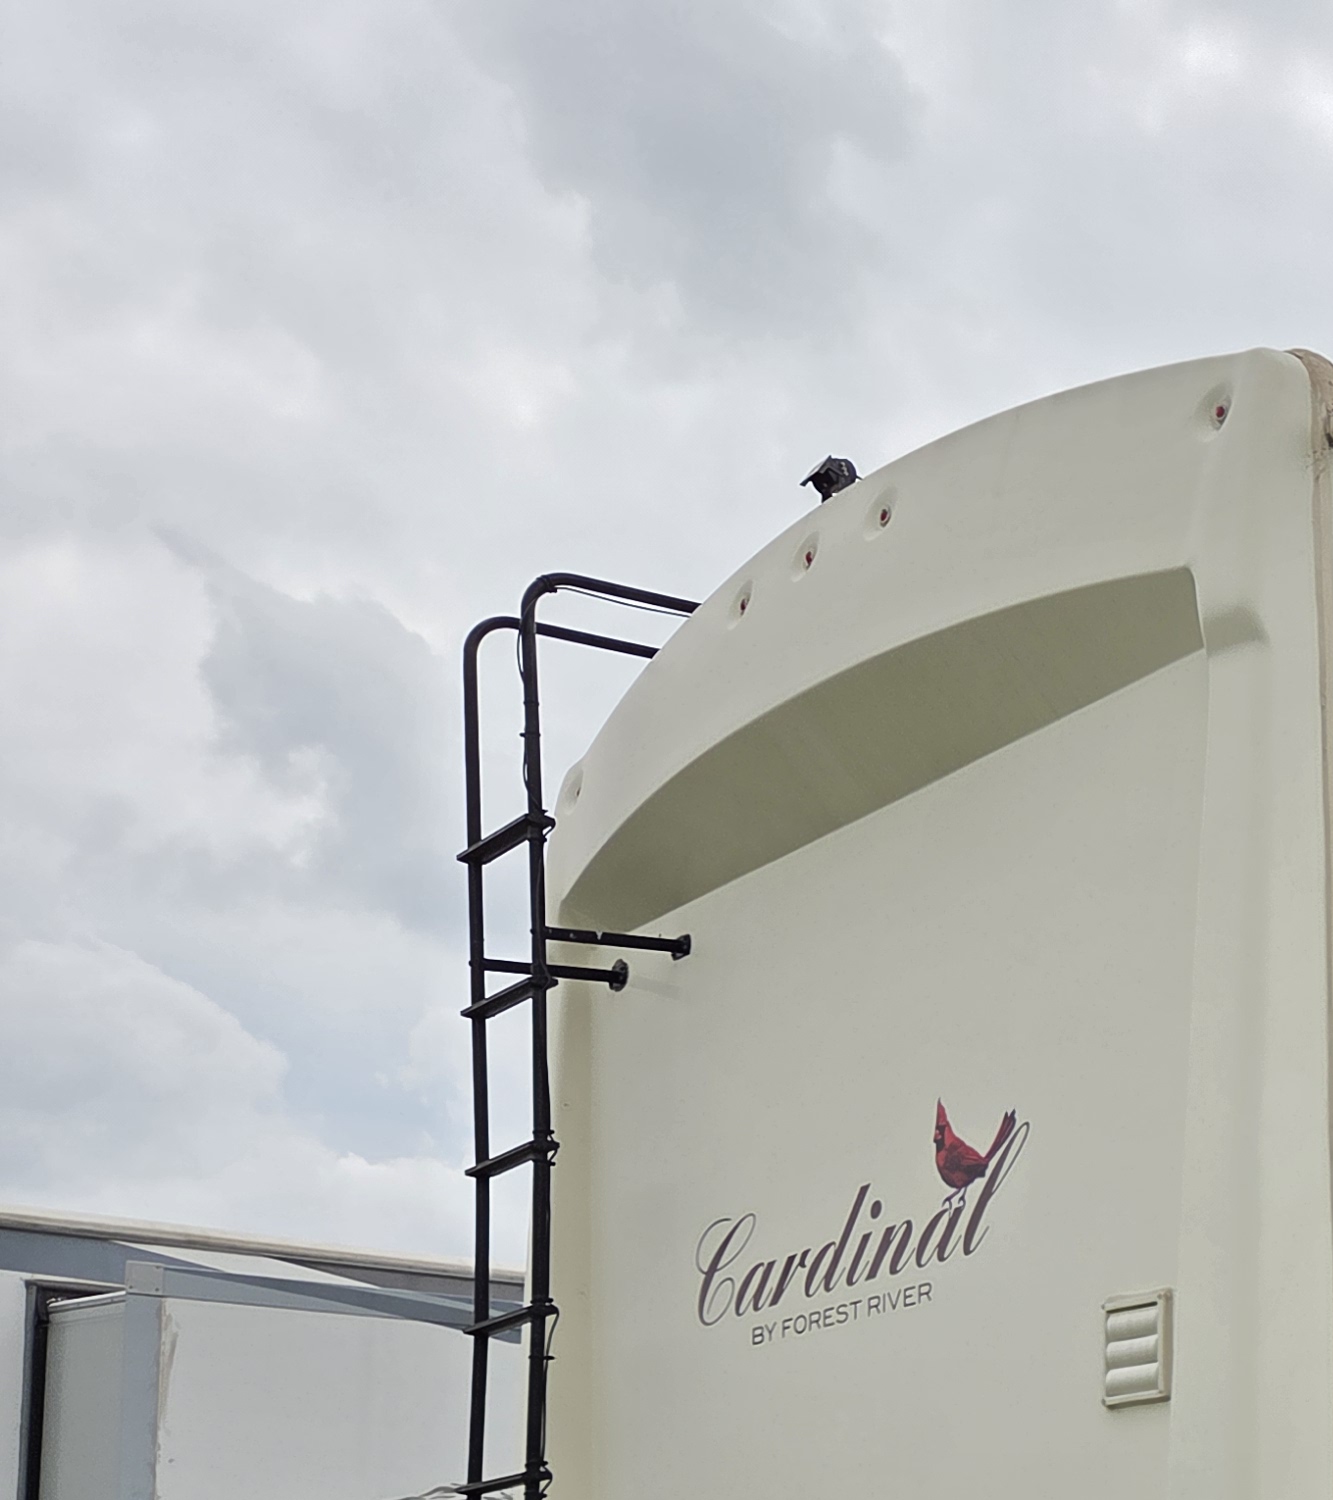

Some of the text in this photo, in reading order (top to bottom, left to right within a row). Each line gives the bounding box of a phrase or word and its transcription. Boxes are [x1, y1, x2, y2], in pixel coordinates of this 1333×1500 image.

[696, 1121, 1031, 1327] Cardinal
[751, 1282, 933, 1346] BY FOREST RIVER
